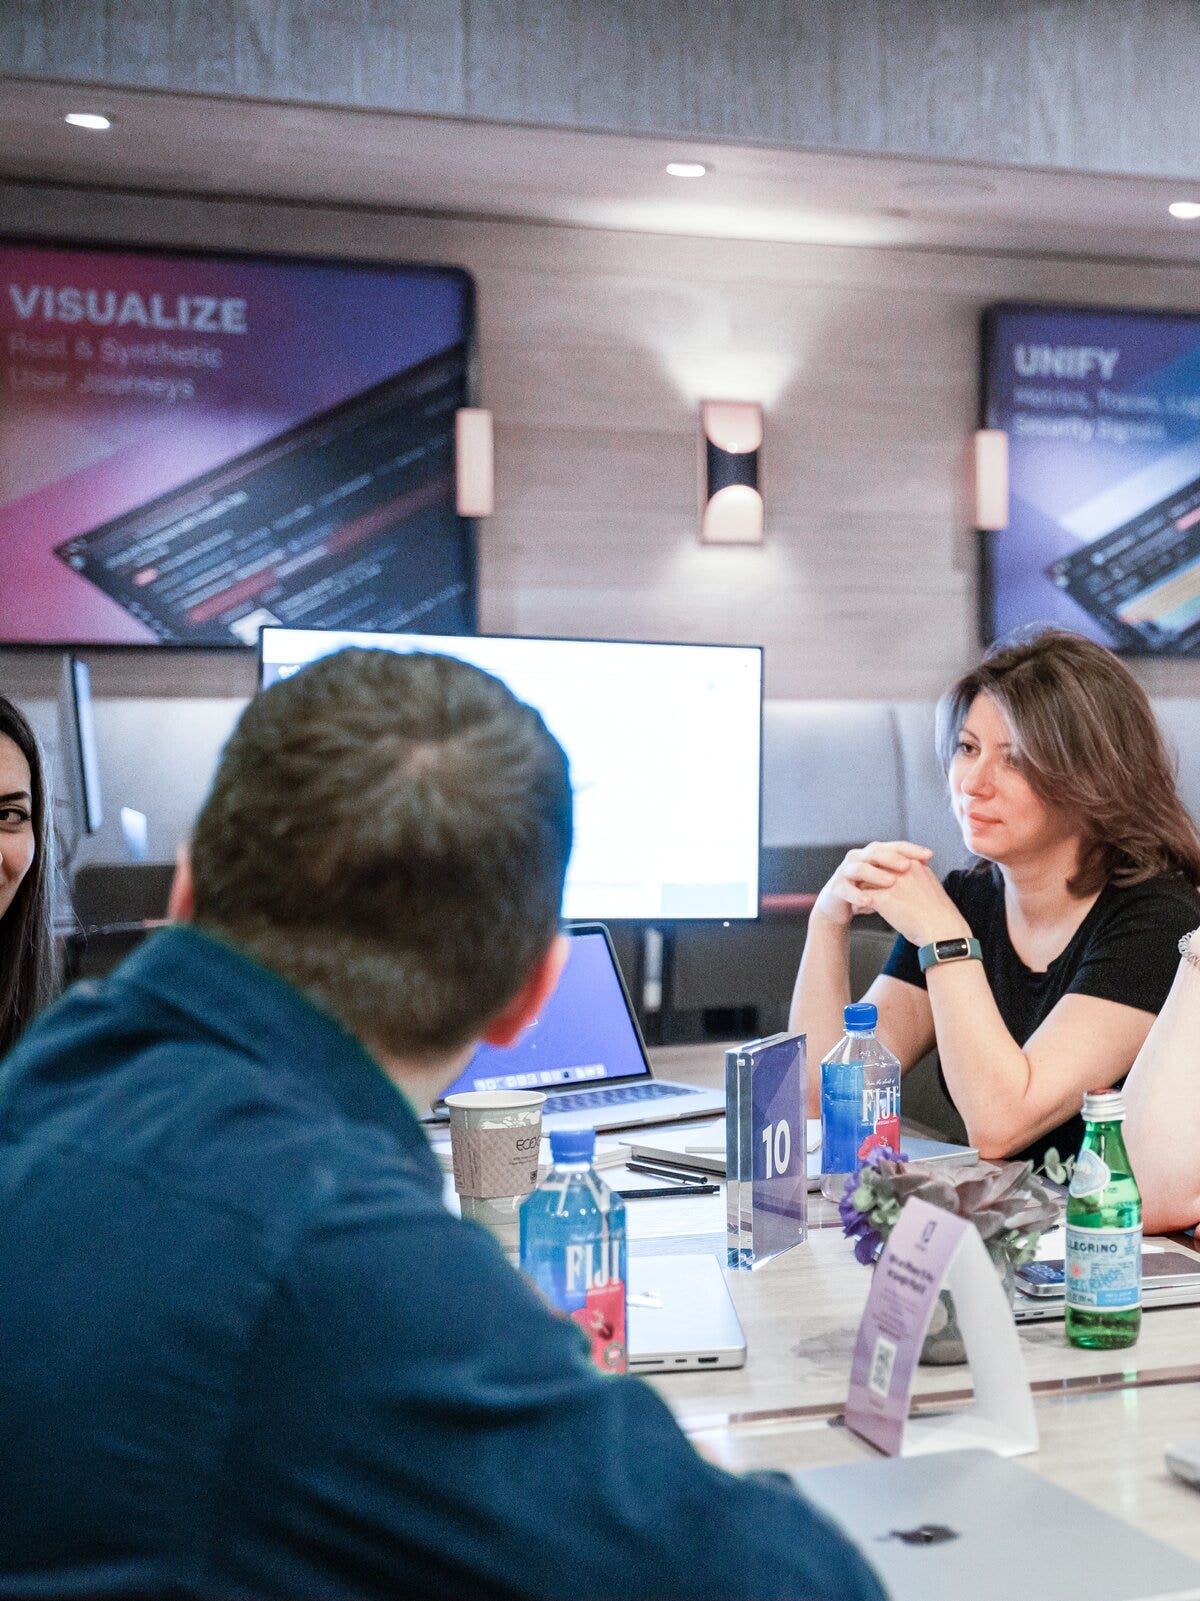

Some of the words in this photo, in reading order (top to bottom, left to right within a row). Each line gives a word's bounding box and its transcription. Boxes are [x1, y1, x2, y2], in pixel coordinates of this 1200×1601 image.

[9, 283, 248, 335] VISUALIZE
[100, 336, 223, 369] Synthetic
[1013, 344, 1120, 382] UNIFY
[862, 1086, 898, 1122] FIJI
[516, 1135, 541, 1152] ECO
[762, 1119, 791, 1180] 10
[565, 1240, 620, 1292] FIJI
